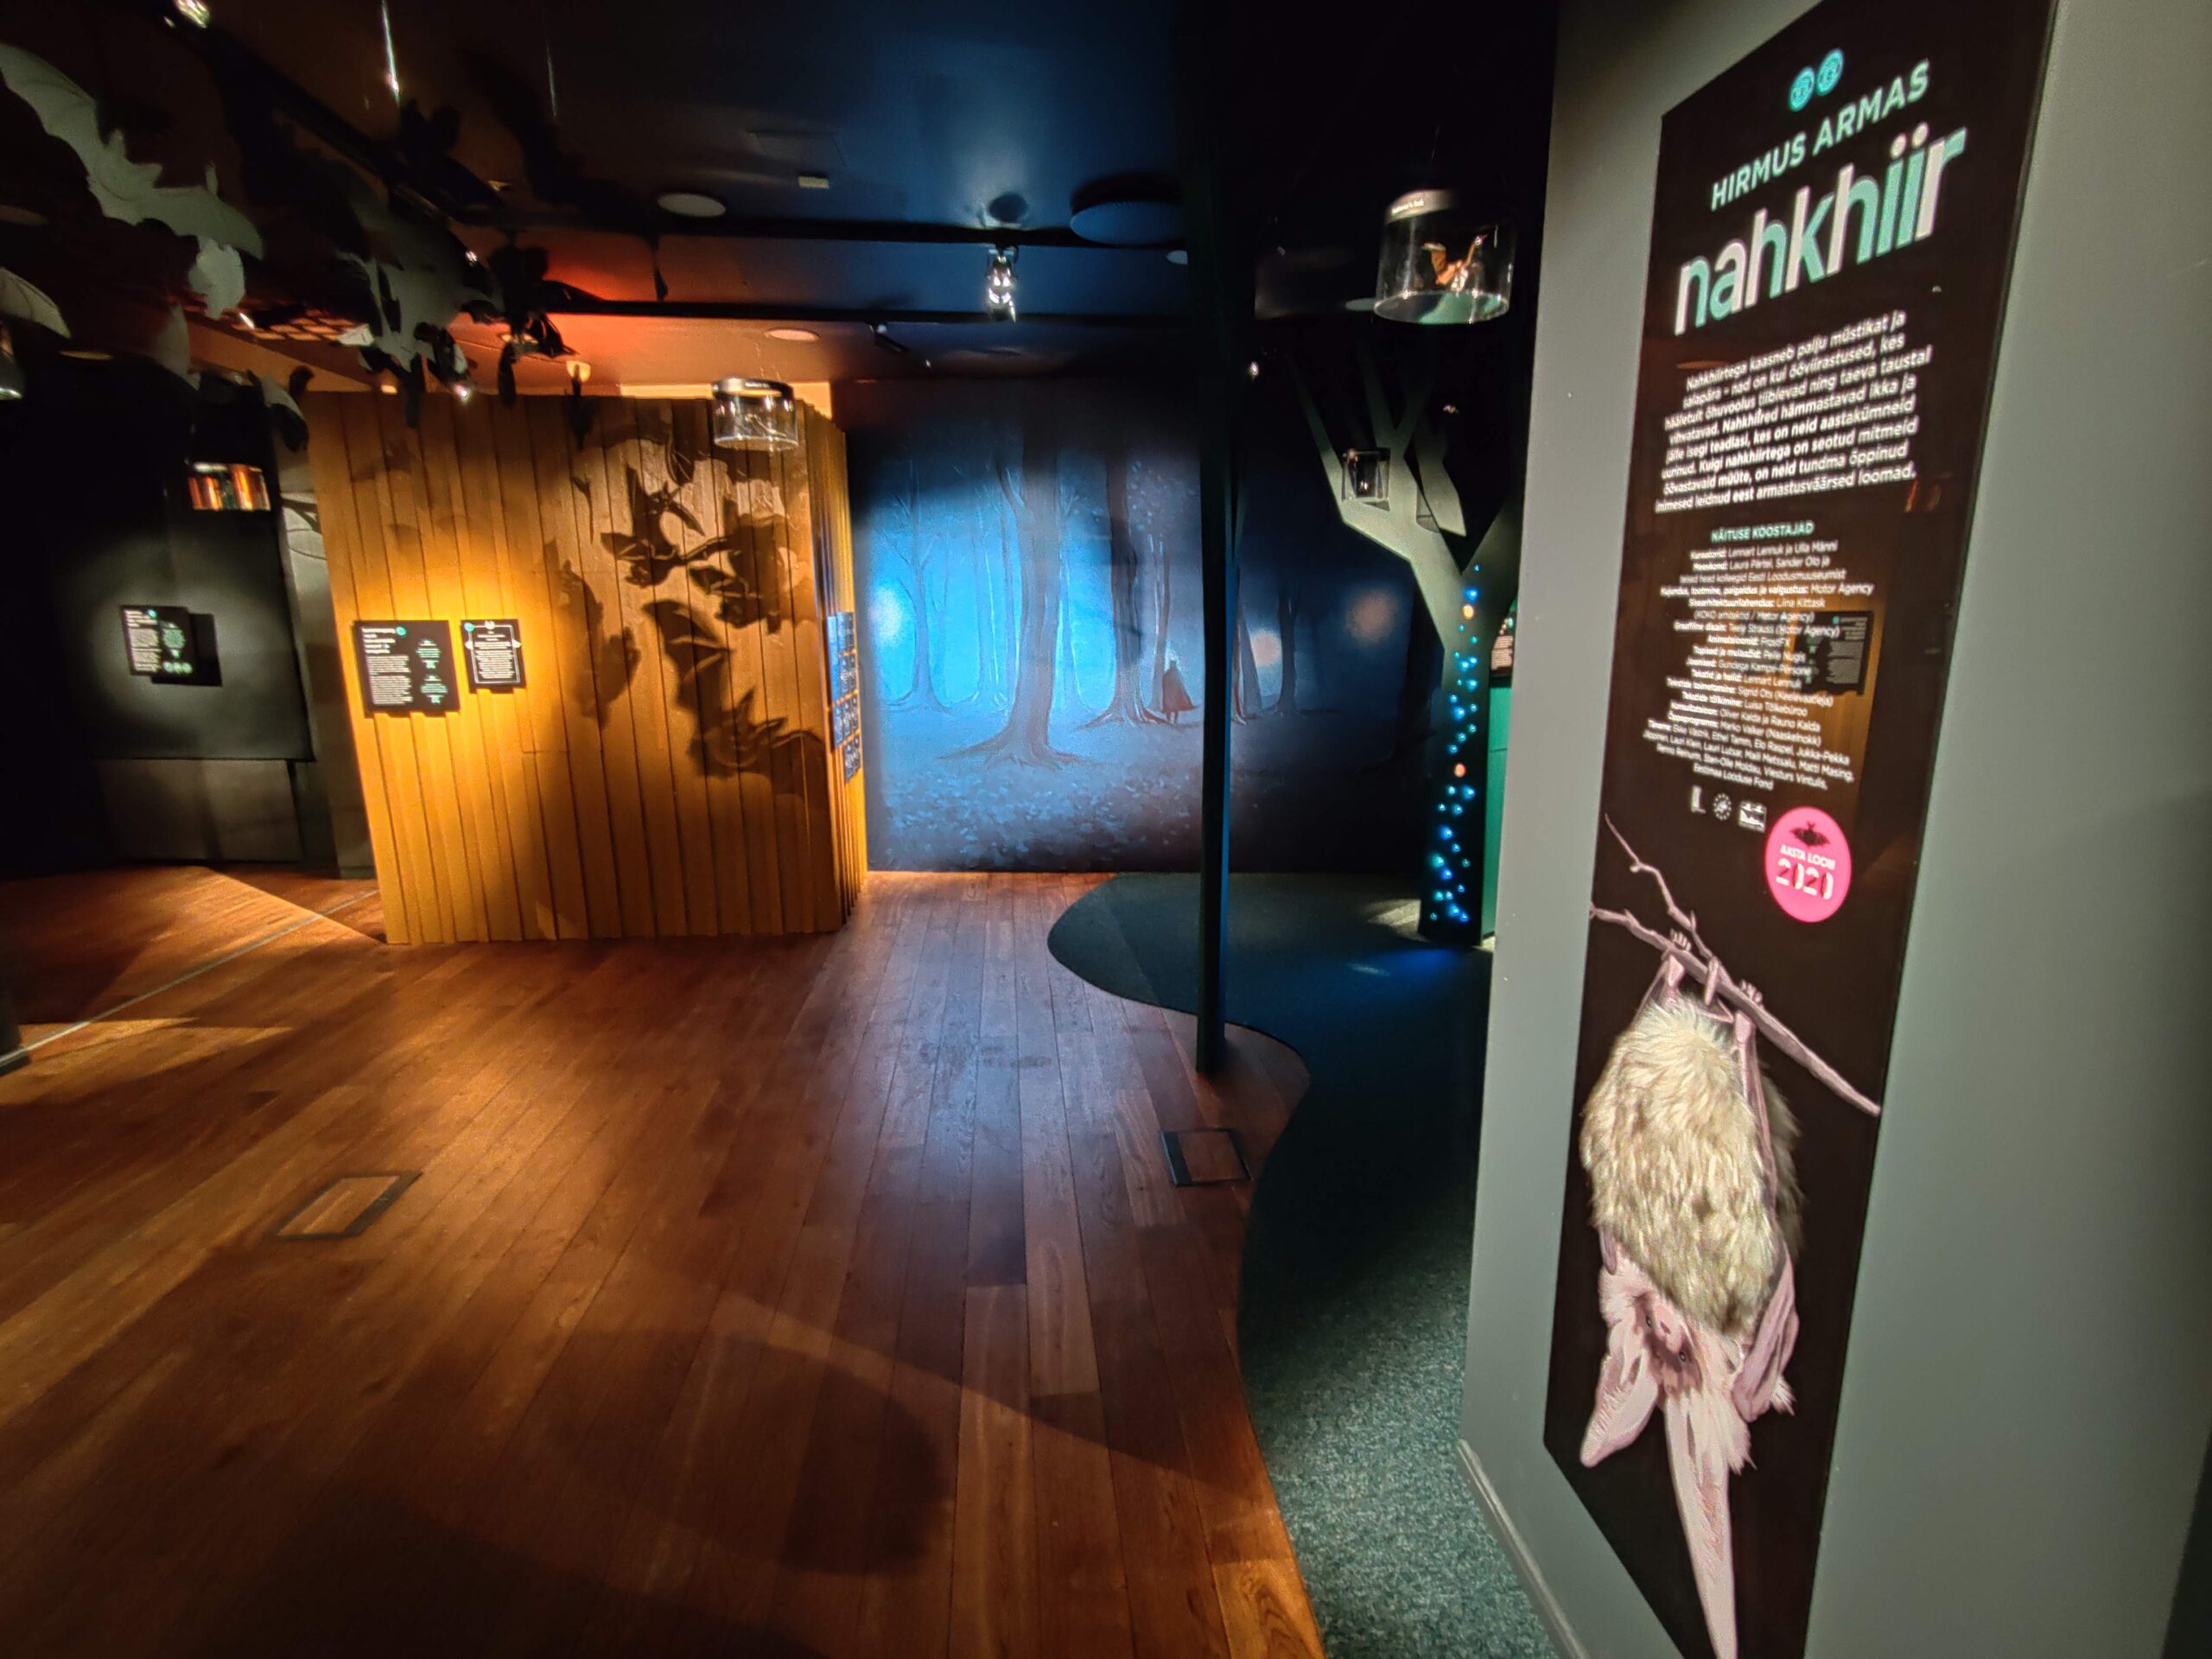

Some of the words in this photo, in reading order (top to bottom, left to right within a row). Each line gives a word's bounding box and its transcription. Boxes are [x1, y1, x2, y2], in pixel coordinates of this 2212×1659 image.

[1710, 130, 1806, 213] HIRMUS
[1812, 59, 1930, 156] ARMAS
[1675, 122, 1967, 336] nahkhiir
[1686, 363, 1747, 391] Nahkhiirtega
[1750, 344, 1795, 371] kaasneb
[1796, 334, 1827, 358] palju
[1830, 315, 1888, 347] müstikat
[1890, 309, 1907, 333] ja
[1731, 378, 1751, 398] nad
[1753, 374, 1767, 390] on
[1770, 366, 1787, 385] kui
[1880, 334, 1906, 358] kes
[1809, 372, 1837, 395] ning
[1840, 359, 1877, 385] taeva
[1880, 344, 1933, 375] taustal
[1687, 437, 1708, 461] isegi
[1710, 426, 1750, 450] teadlasi,
[1753, 422, 1771, 444] kes
[1774, 420, 1789, 437] on
[1791, 413, 1817, 436] neid
[1821, 395, 1916, 430] aastakümneid
[1722, 404, 1778, 433] Nahkhiired
[1780, 385, 1865, 418] hämmastavad
[1869, 375, 1898, 400] ikka
[1900, 373, 1916, 396] ja
[1699, 449, 1724, 474] Kuigi
[1726, 437, 1790, 469] nahkhiirtega
[1793, 437, 1808, 453] on
[1811, 425, 1855, 452] seotud
[1858, 416, 1919, 444] mitmeid
[1755, 461, 1769, 479] on
[1771, 454, 1796, 478] neid
[1799, 446, 1846, 472] tundma
[1849, 440, 1909, 468] õppinud
[1732, 482, 1754, 503] eest
[1858, 461, 1917, 485] loomad.
[1752, 520, 1815, 539] KOOSTAJAD
[1838, 582, 1875, 595] Agency
[1775, 858, 1834, 900] 2020
[1779, 844, 1806, 861] AASTA
